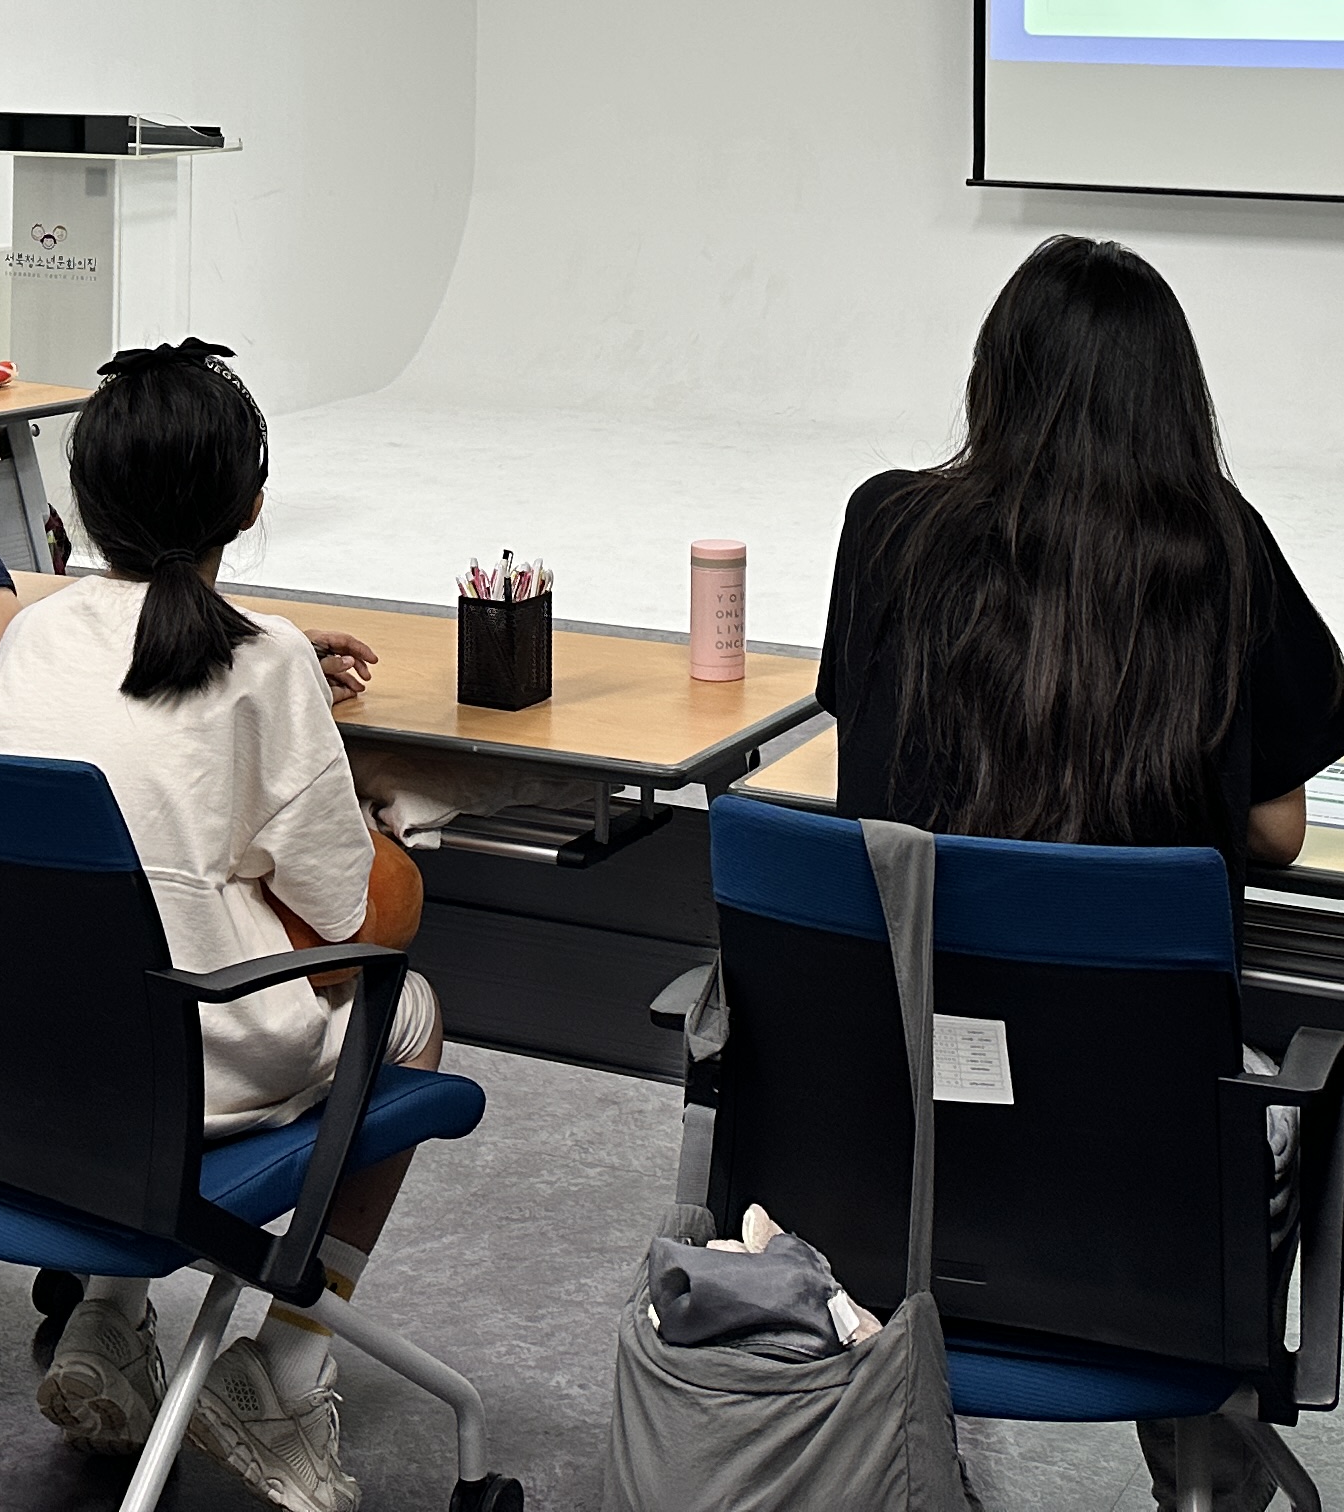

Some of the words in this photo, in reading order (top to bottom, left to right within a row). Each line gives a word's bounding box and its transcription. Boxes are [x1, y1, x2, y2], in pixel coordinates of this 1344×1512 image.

[5, 252, 97, 272] 성북청소년문화의집
[717, 592, 744, 603] YOU
[715, 608, 744, 619] ONLY
[715, 638, 744, 649] ONCE
